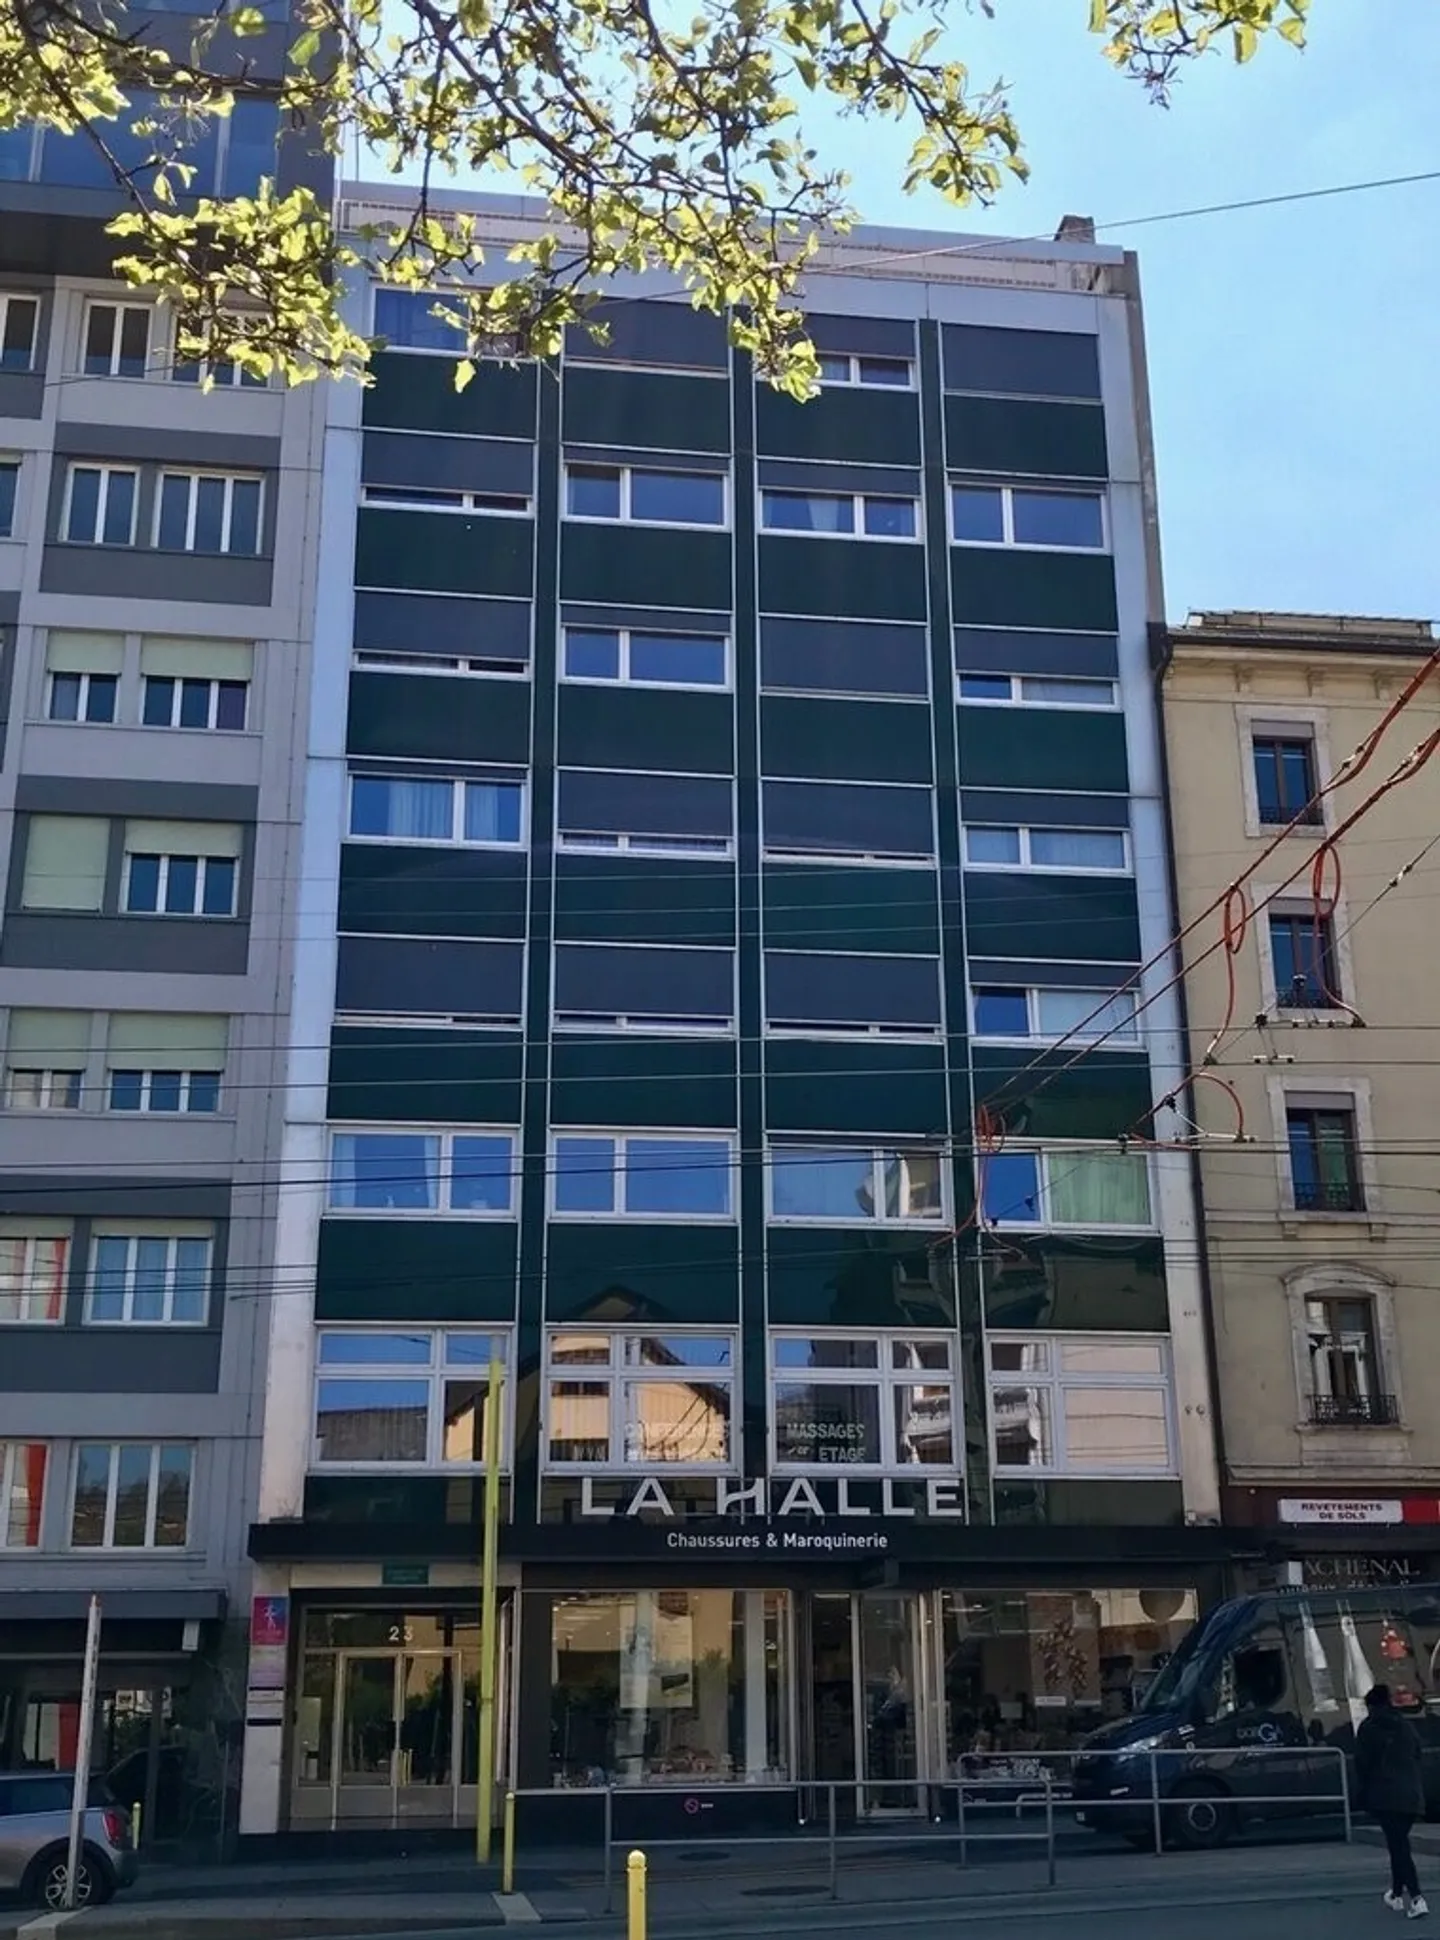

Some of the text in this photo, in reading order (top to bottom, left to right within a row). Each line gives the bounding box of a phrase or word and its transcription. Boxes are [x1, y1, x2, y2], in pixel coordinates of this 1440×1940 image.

[786, 1422, 865, 1439] MASSAGES
[582, 1477, 962, 1516] LA HALLE
[667, 1532, 888, 1550] Chaussures & Maroquinerie
[1303, 1558, 1420, 1575] ACHENAL
[389, 1625, 413, 1641] 23
